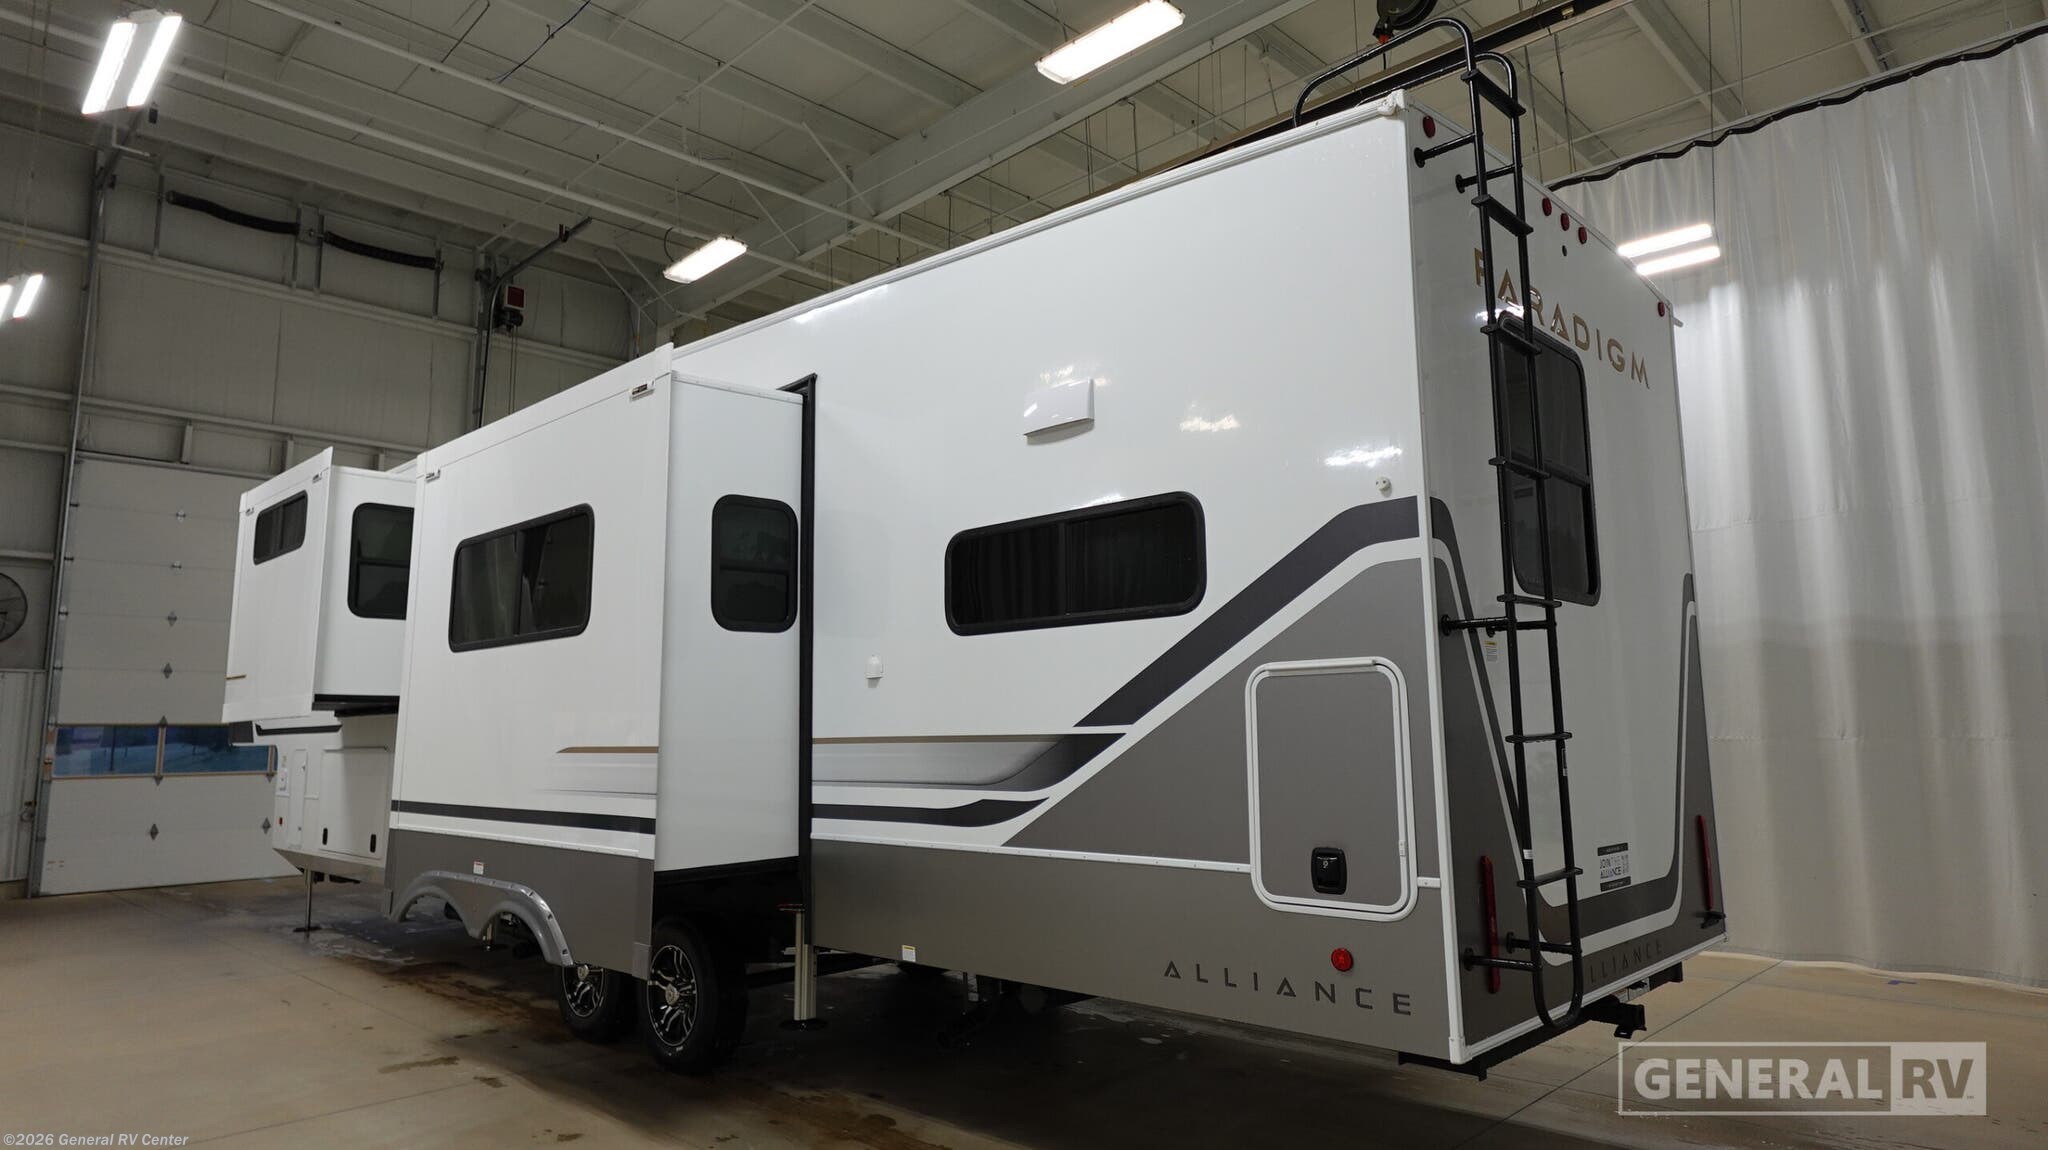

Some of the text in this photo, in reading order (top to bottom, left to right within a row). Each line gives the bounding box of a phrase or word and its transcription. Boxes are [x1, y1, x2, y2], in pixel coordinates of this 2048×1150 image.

[1474, 247, 1650, 389] PARADIGM
[1164, 960, 1411, 1016] ALLIANCE
[1586, 938, 1663, 985] LLIANCE
